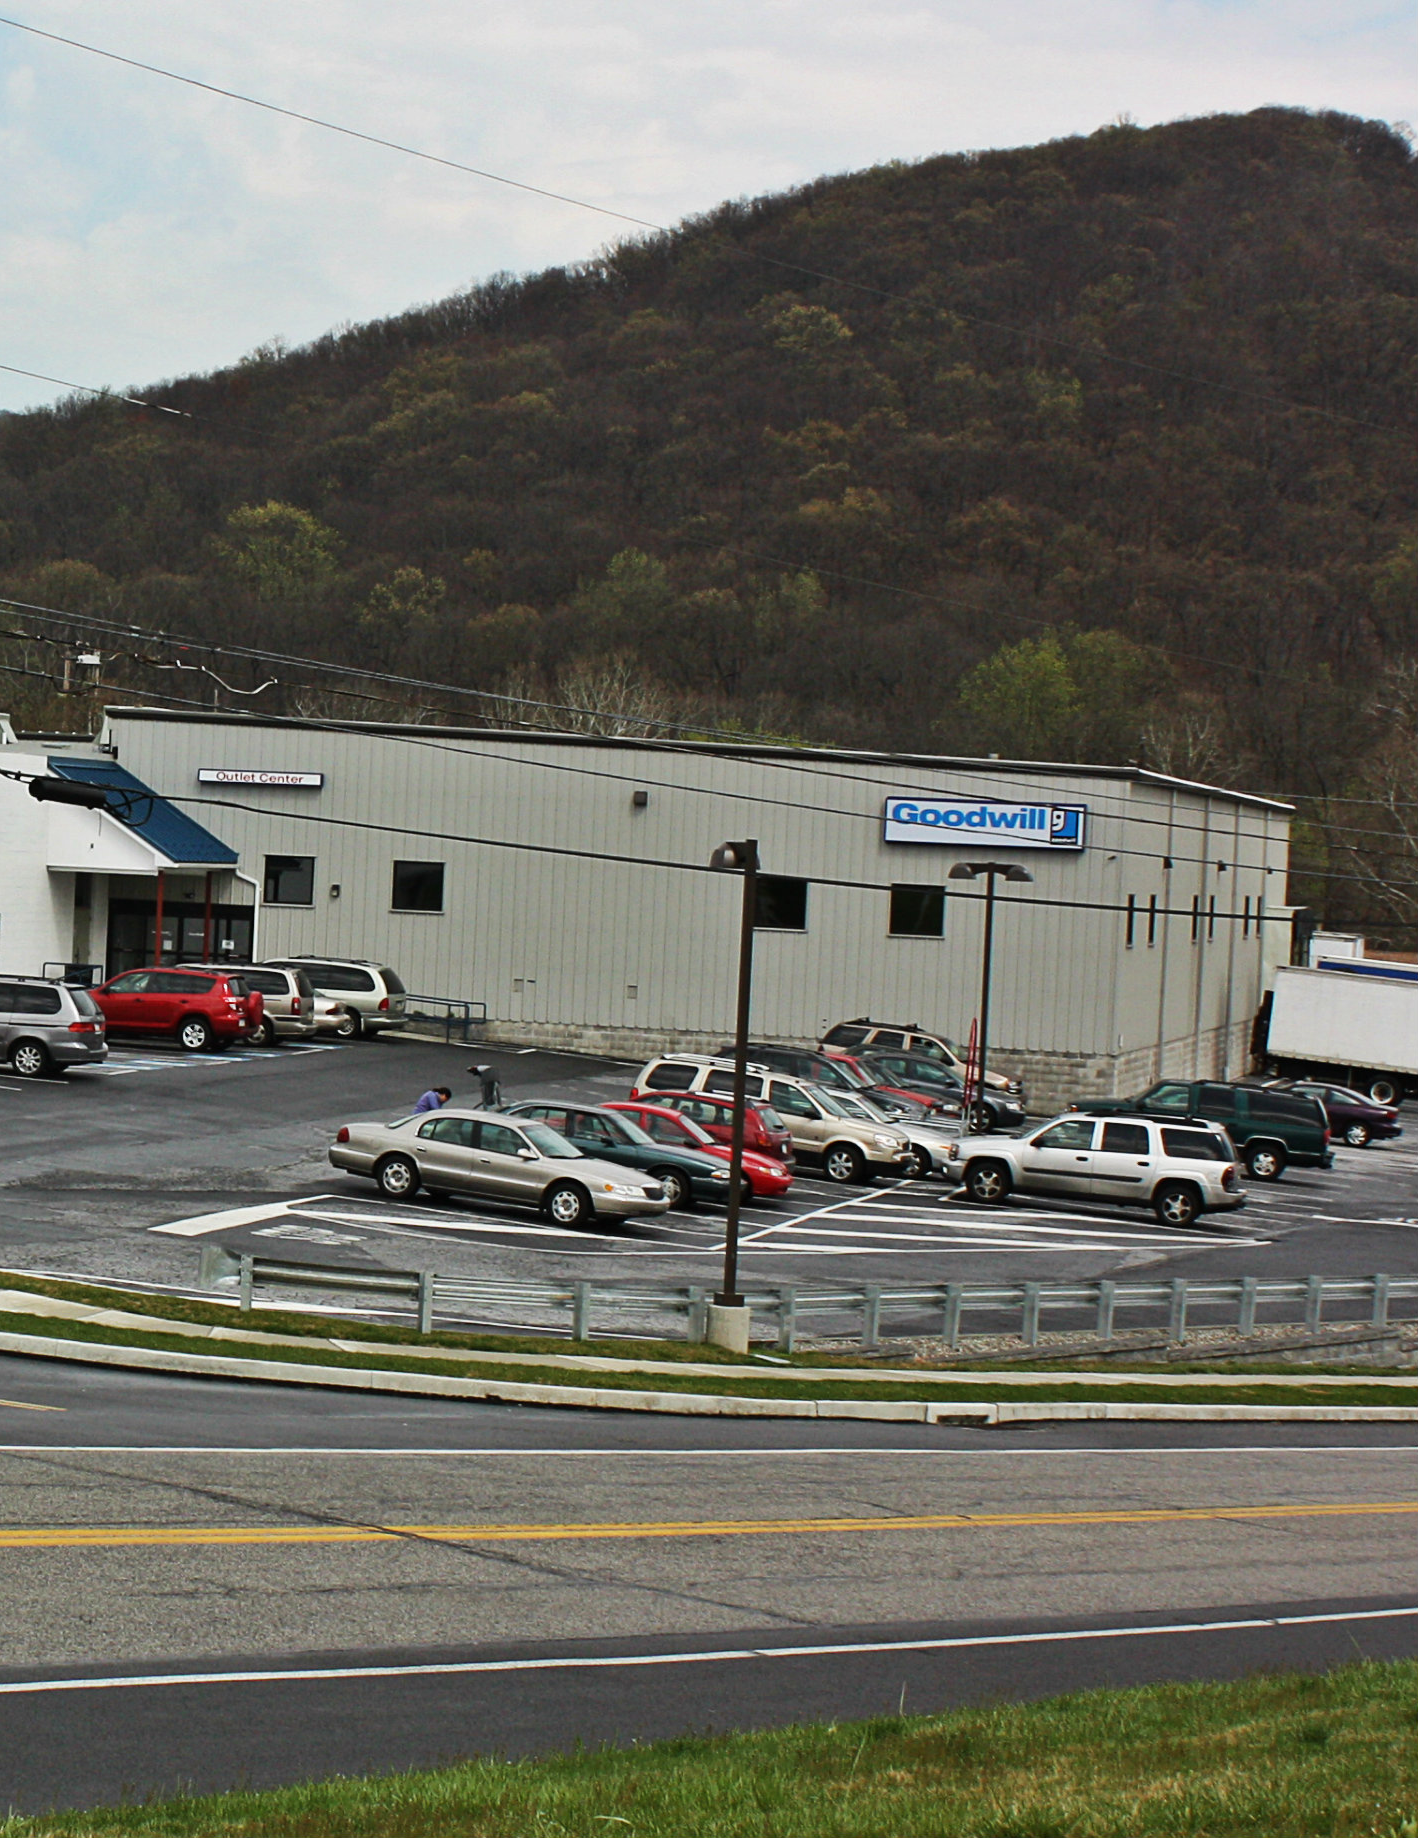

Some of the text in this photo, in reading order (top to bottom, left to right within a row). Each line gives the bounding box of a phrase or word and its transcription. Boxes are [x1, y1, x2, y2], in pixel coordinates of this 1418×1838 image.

[216, 771, 304, 784] Outlet Center
[892, 803, 1046, 830] Goodwill
